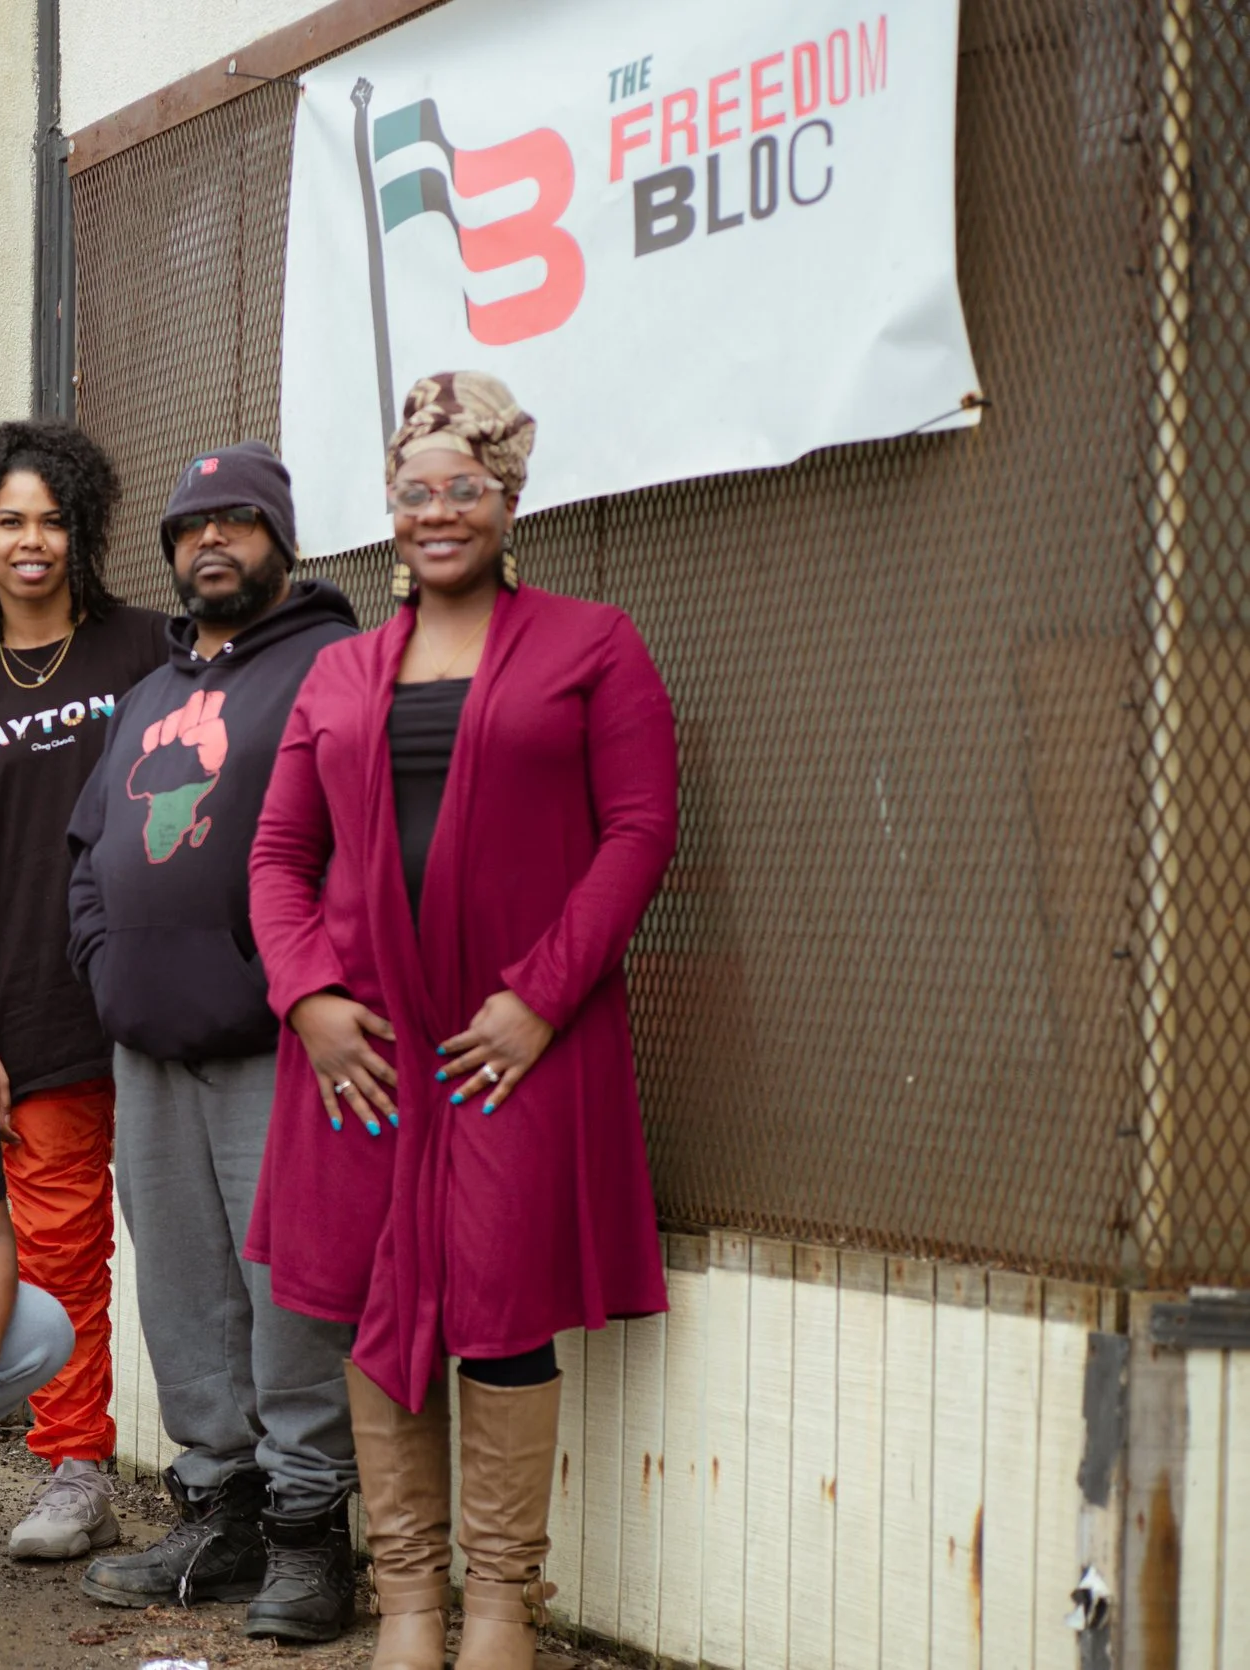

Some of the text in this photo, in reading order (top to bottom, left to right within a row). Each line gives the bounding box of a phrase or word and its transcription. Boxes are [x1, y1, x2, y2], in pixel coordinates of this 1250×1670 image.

[608, 54, 654, 104] THE
[609, 13, 888, 184] FREEDOM
[633, 118, 834, 259] BLOC
